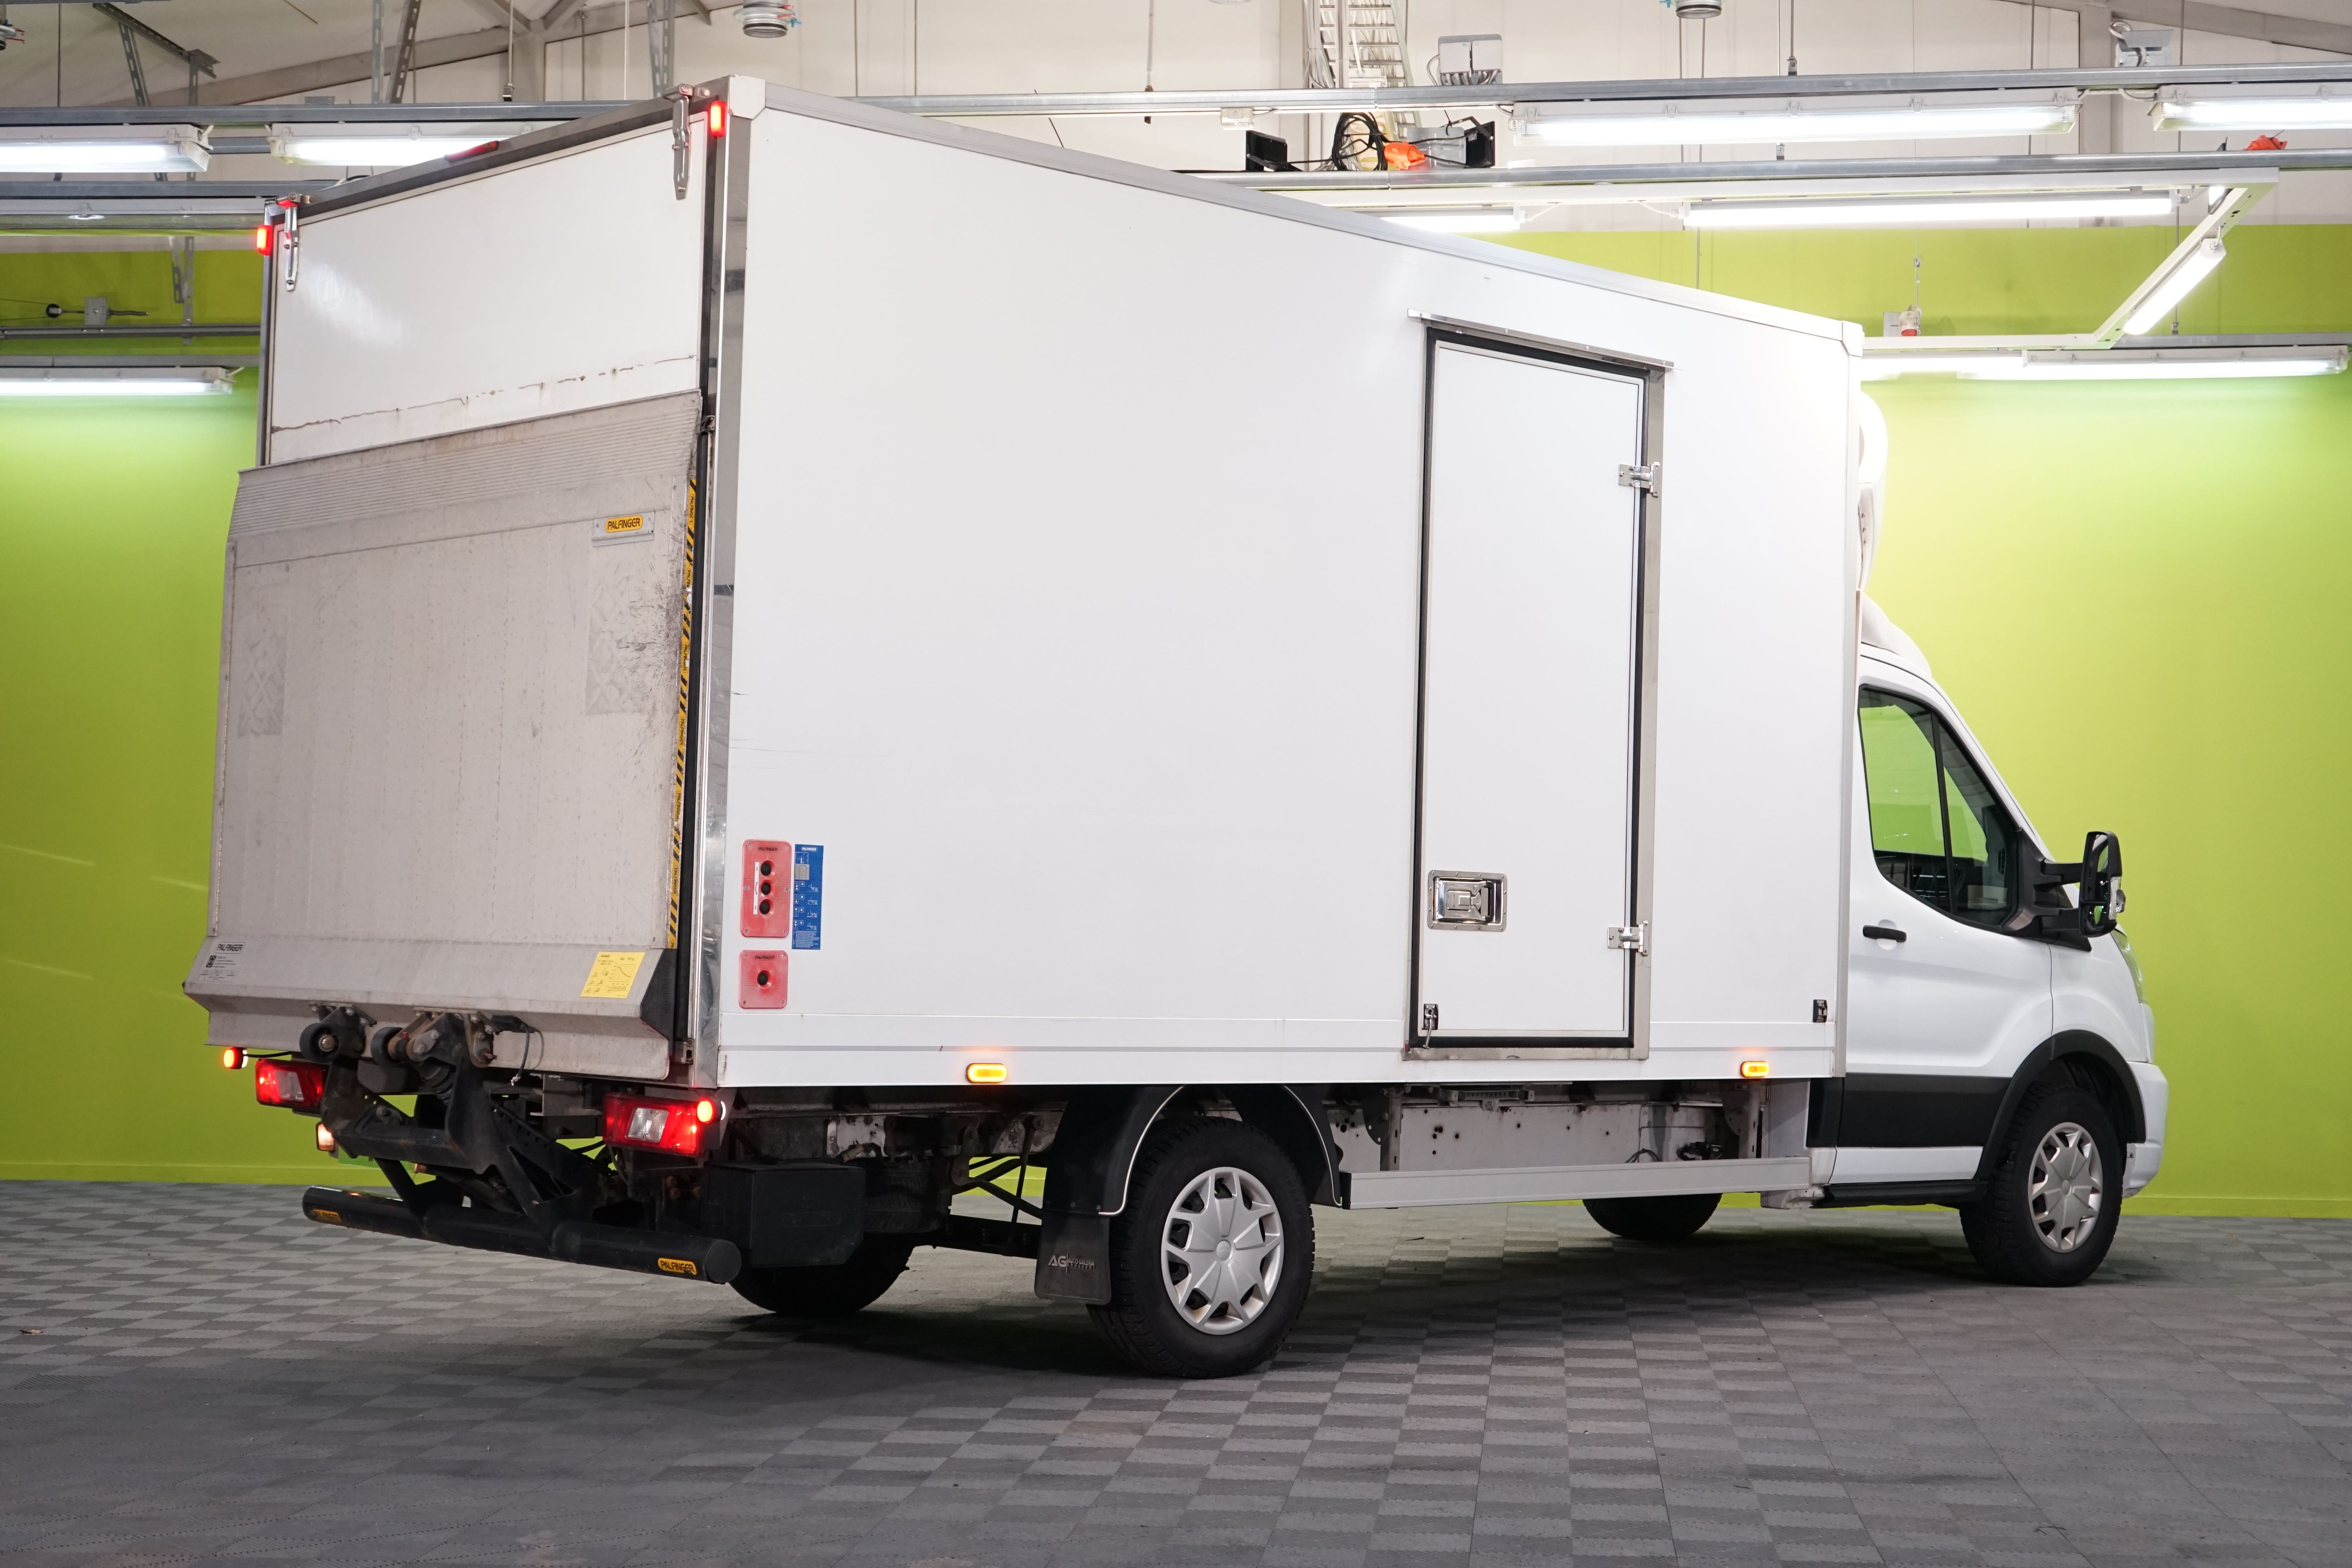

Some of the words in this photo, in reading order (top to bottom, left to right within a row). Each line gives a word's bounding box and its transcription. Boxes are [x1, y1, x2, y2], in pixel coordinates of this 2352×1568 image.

[608, 518, 640, 530] PALFINGER
[661, 1261, 695, 1272] PALFINGER
[1048, 1255, 1067, 1267] AG
